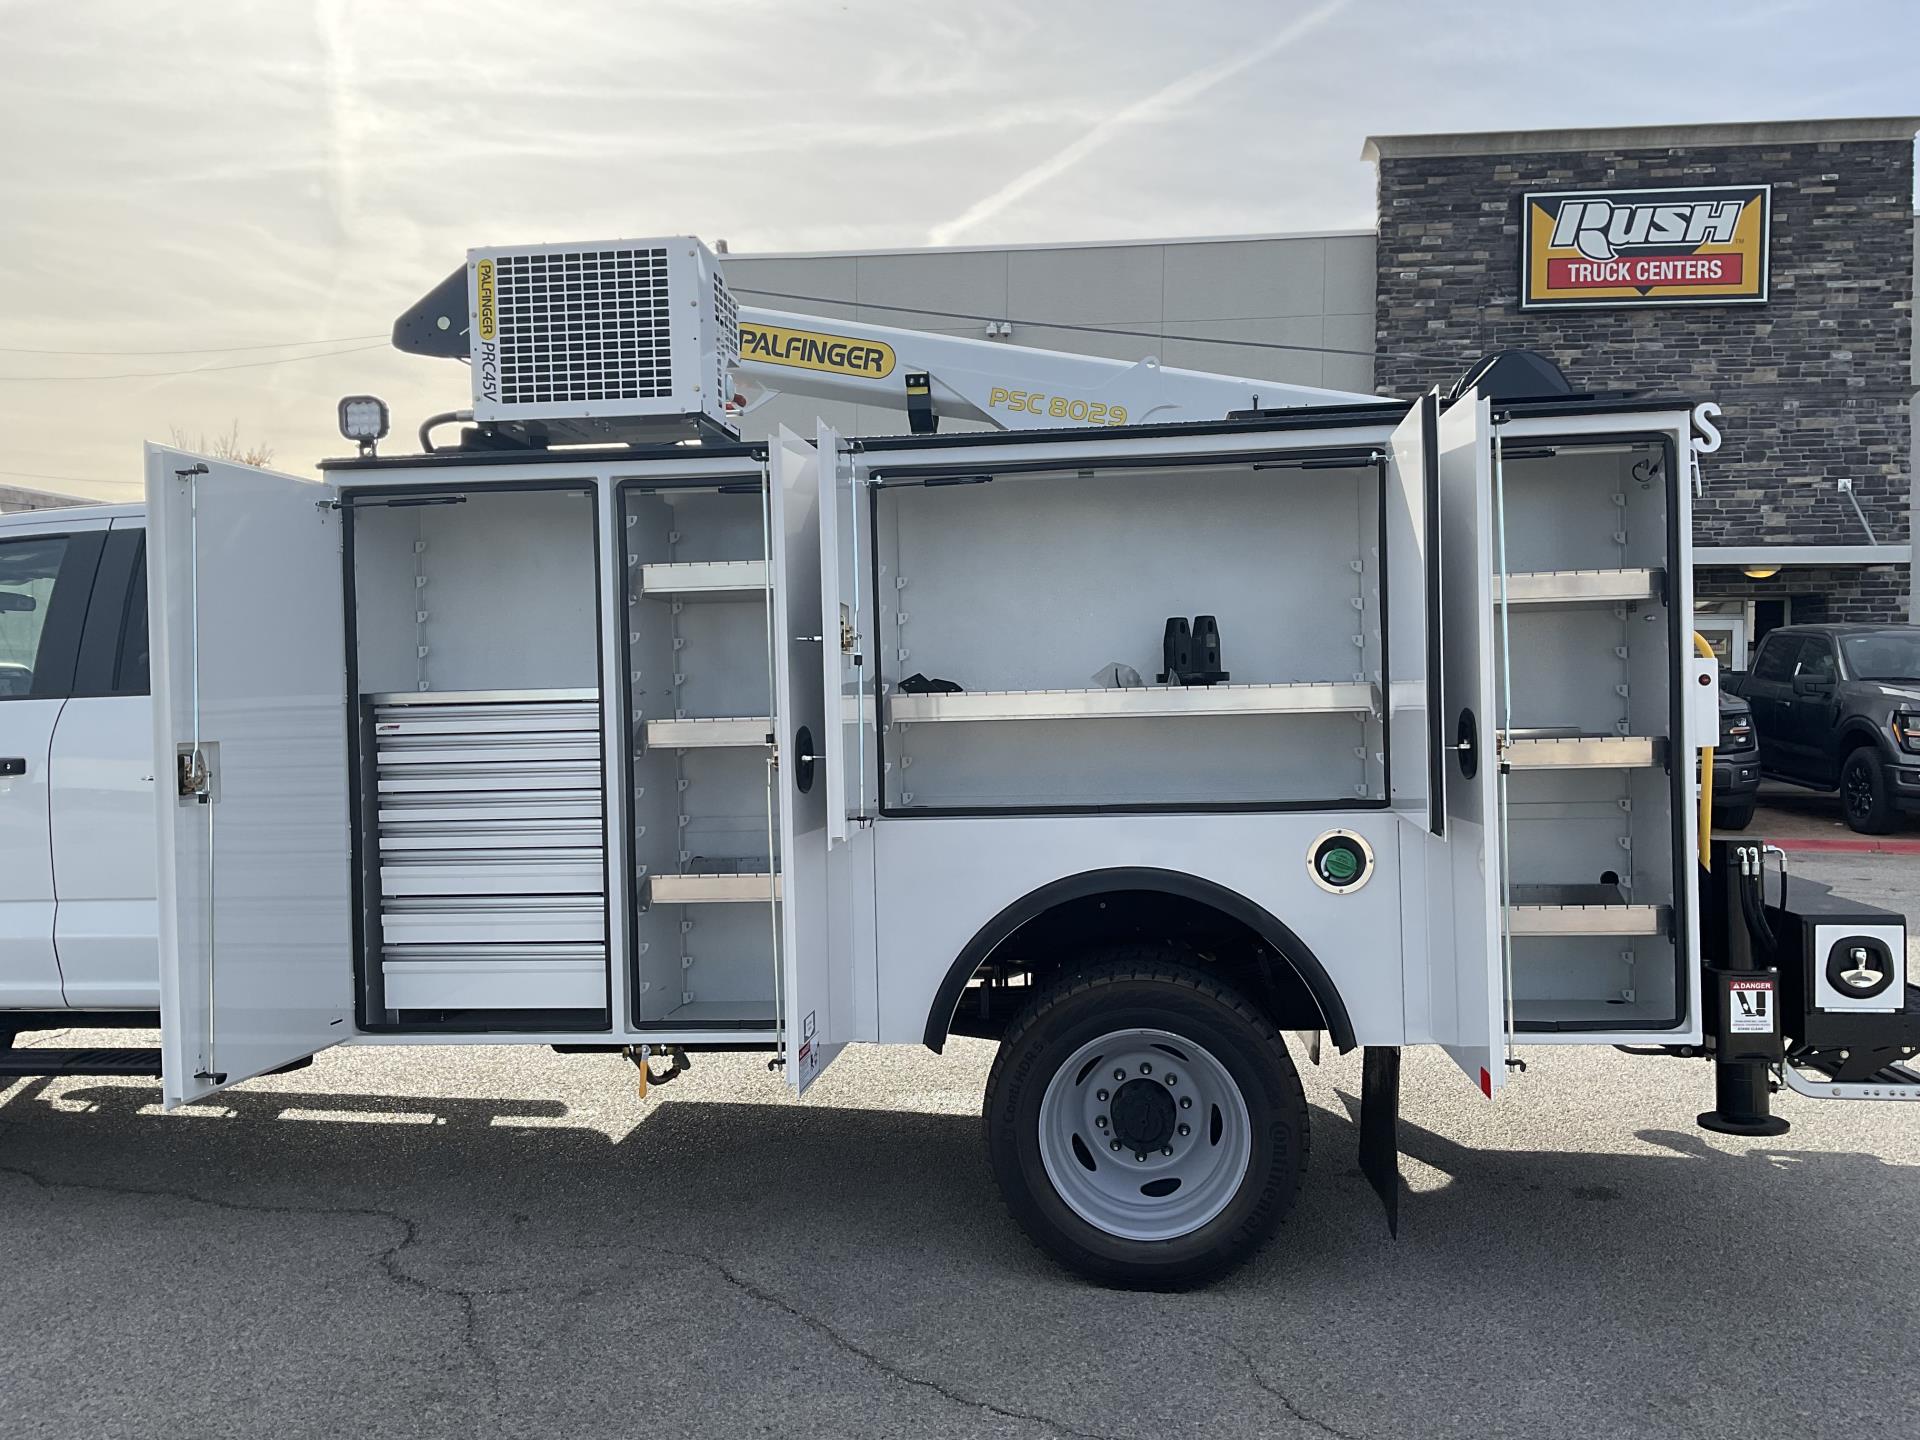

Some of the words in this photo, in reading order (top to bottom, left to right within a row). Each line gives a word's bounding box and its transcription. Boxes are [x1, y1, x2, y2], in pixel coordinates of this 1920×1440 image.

[1568, 263, 1631, 282] TRUCK
[1636, 260, 1722, 280] CENTERS
[481, 264, 494, 335] PALFINGER
[481, 342, 498, 403] PRC45V
[740, 329, 884, 373] PALFINGER
[989, 387, 1043, 415] PSC
[1048, 396, 1128, 427] 8029
[1013, 1052, 1037, 1083] HDR
[1242, 1120, 1291, 1238] Continental
